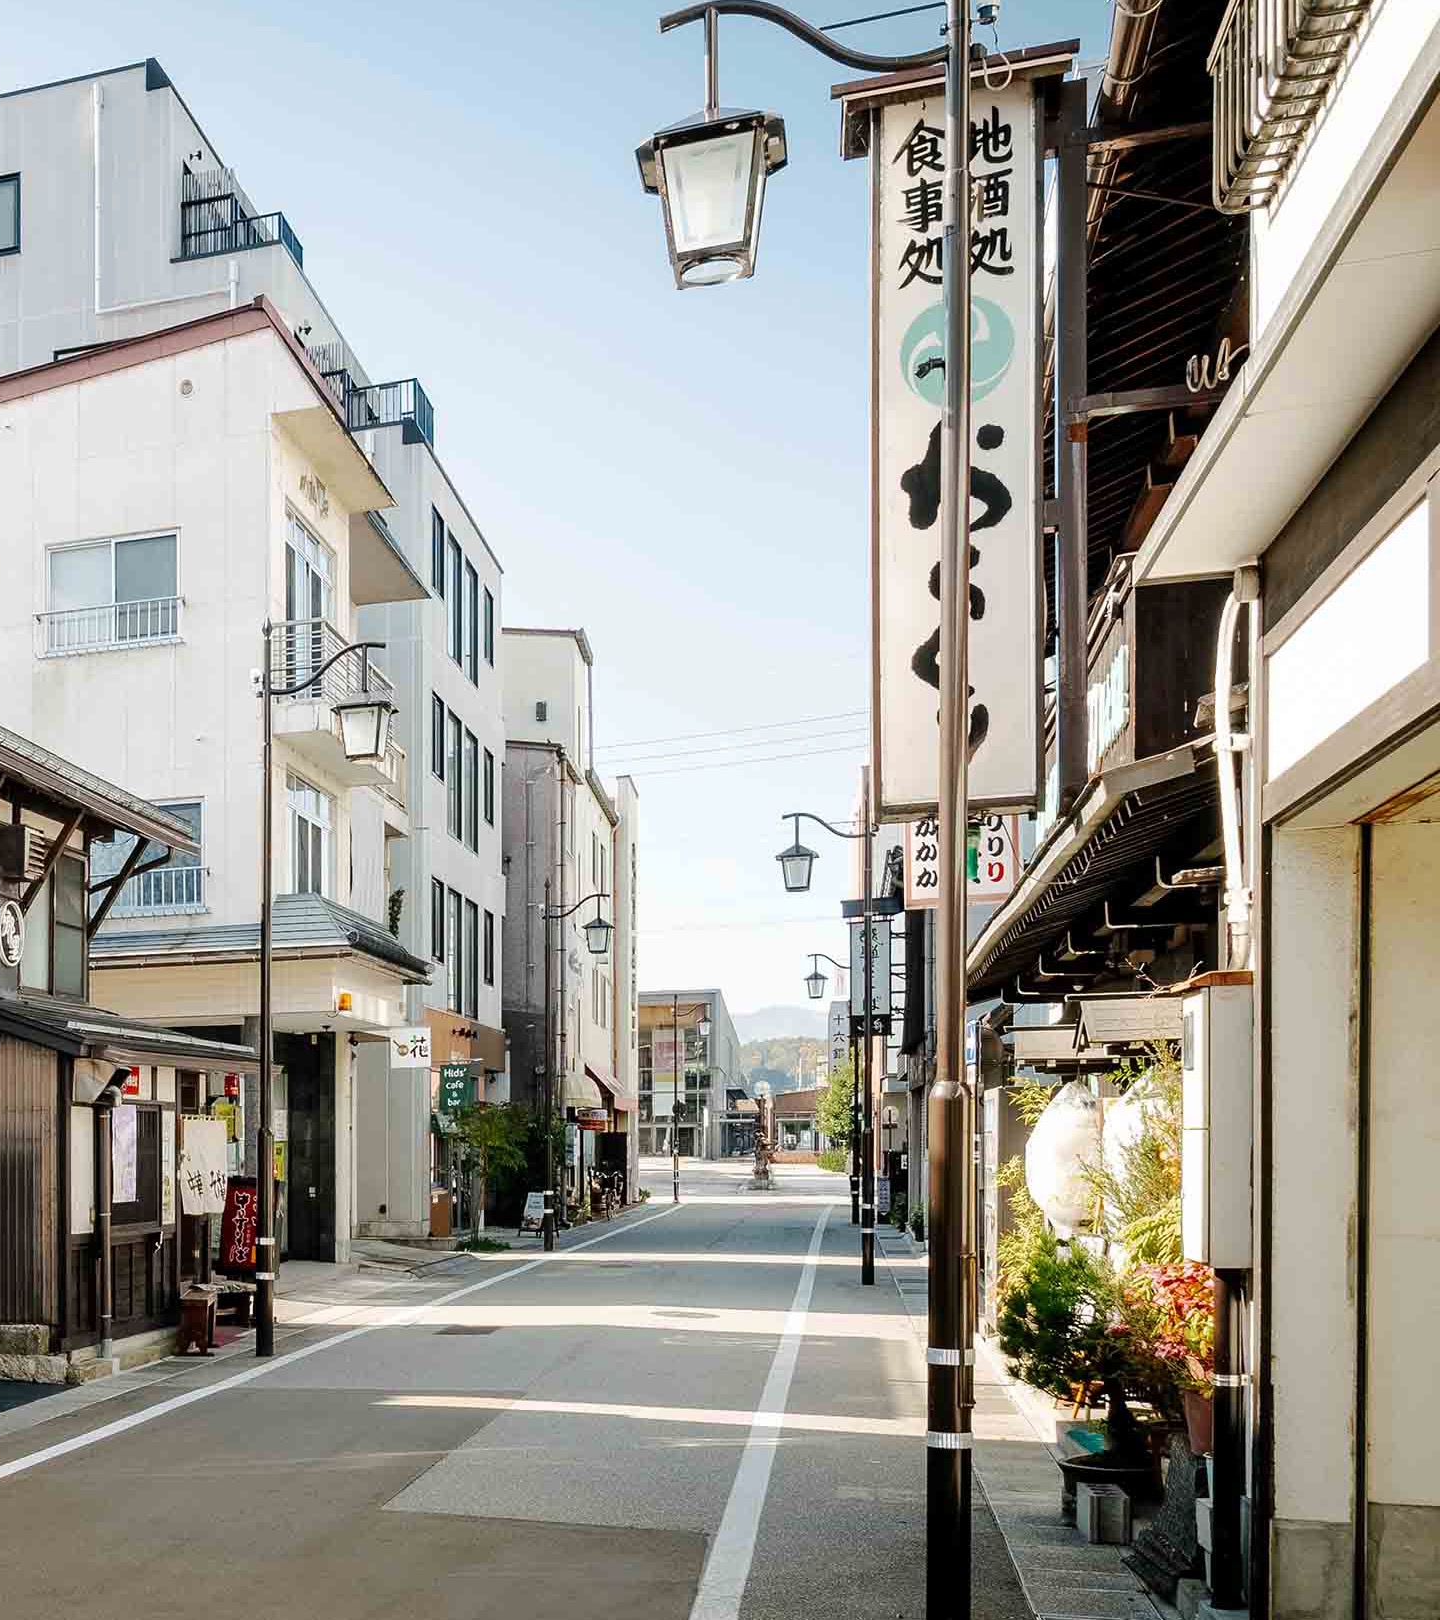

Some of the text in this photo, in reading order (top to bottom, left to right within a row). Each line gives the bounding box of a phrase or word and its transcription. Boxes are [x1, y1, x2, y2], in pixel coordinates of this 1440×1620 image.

[892, 118, 945, 290] 食事処
[969, 105, 1014, 276] 地酒処
[447, 1098, 462, 1107] bar
